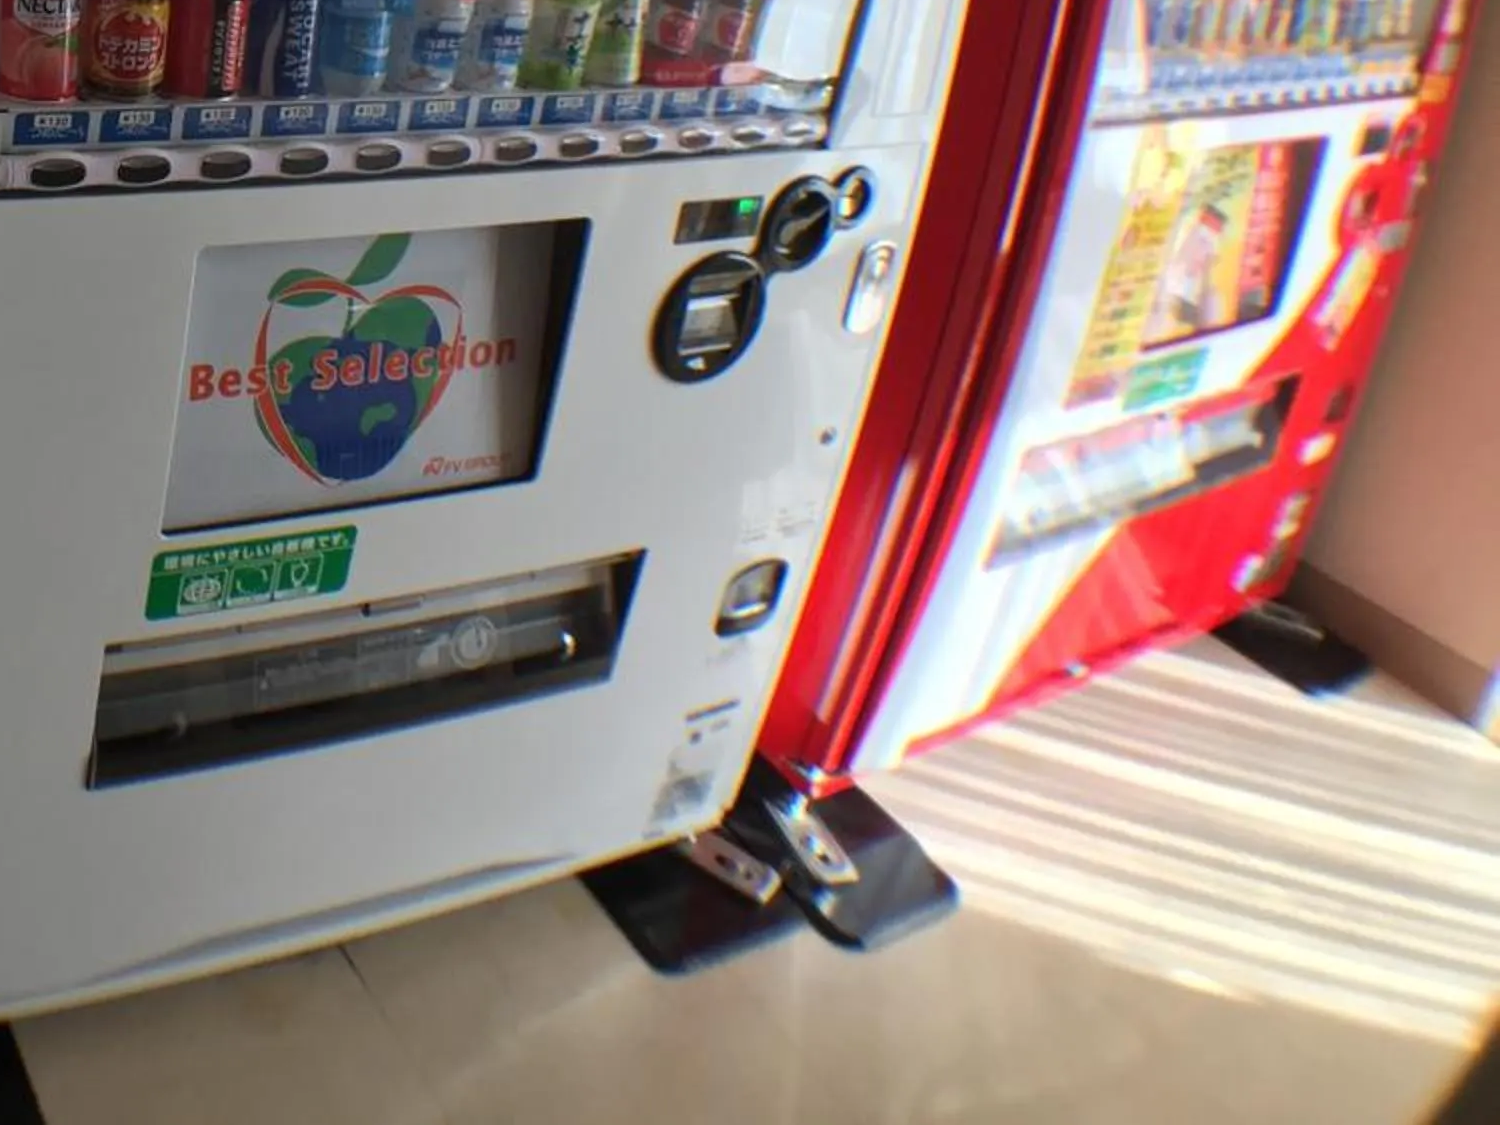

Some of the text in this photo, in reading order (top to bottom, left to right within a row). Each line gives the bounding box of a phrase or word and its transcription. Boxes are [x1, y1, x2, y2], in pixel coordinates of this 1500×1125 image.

[99, 36, 161, 54] ドデカミン
[101, 52, 159, 72] ストロング
[188, 335, 517, 402] Best Selection
